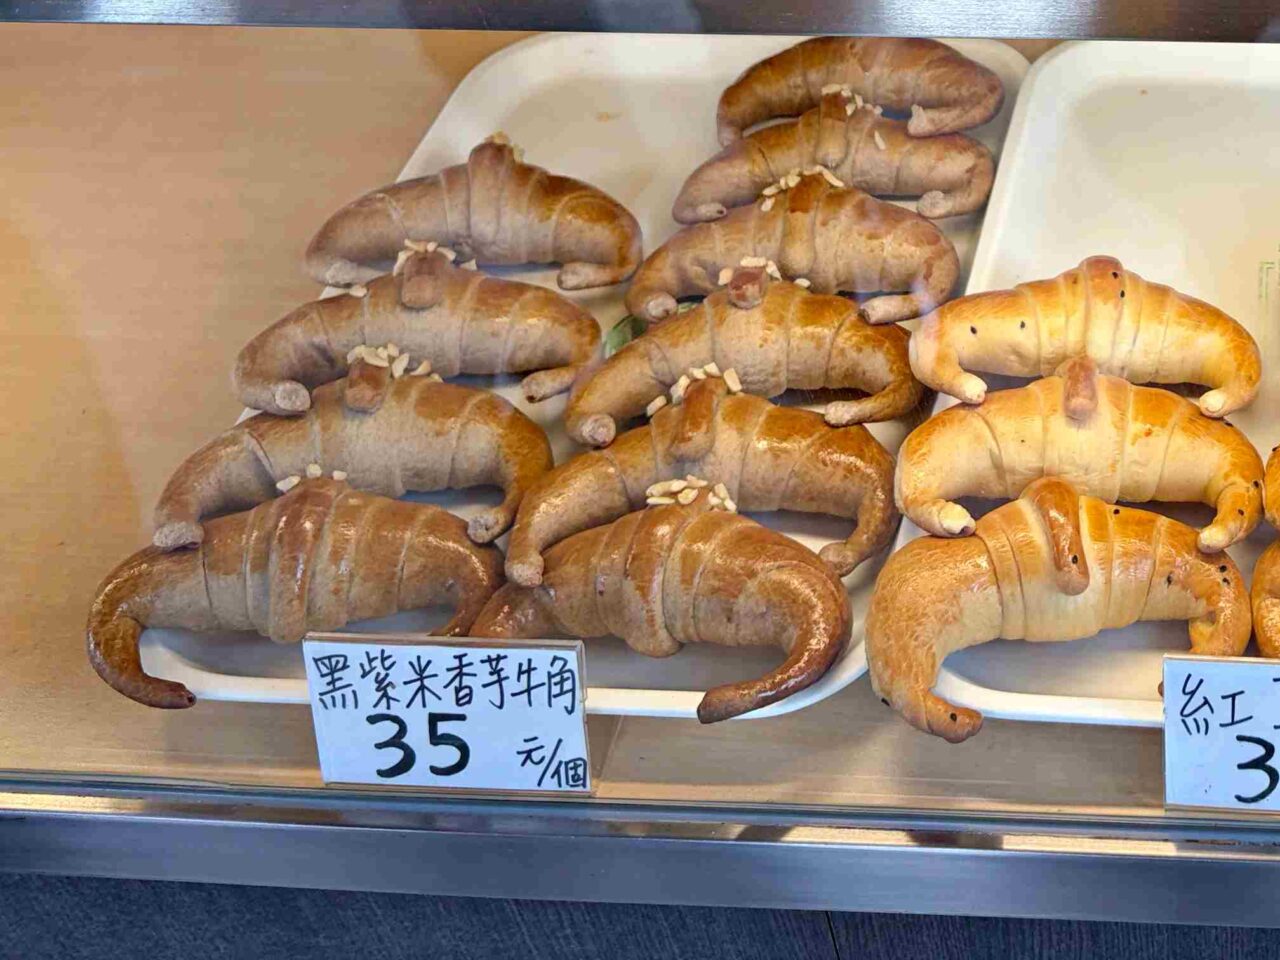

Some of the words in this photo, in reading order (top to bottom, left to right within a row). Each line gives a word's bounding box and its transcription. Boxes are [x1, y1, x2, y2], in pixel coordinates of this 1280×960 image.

[312, 648, 577, 715] 黑紫米香芋牛角
[365, 712, 471, 779] 35
[517, 736, 588, 789] 元/個
